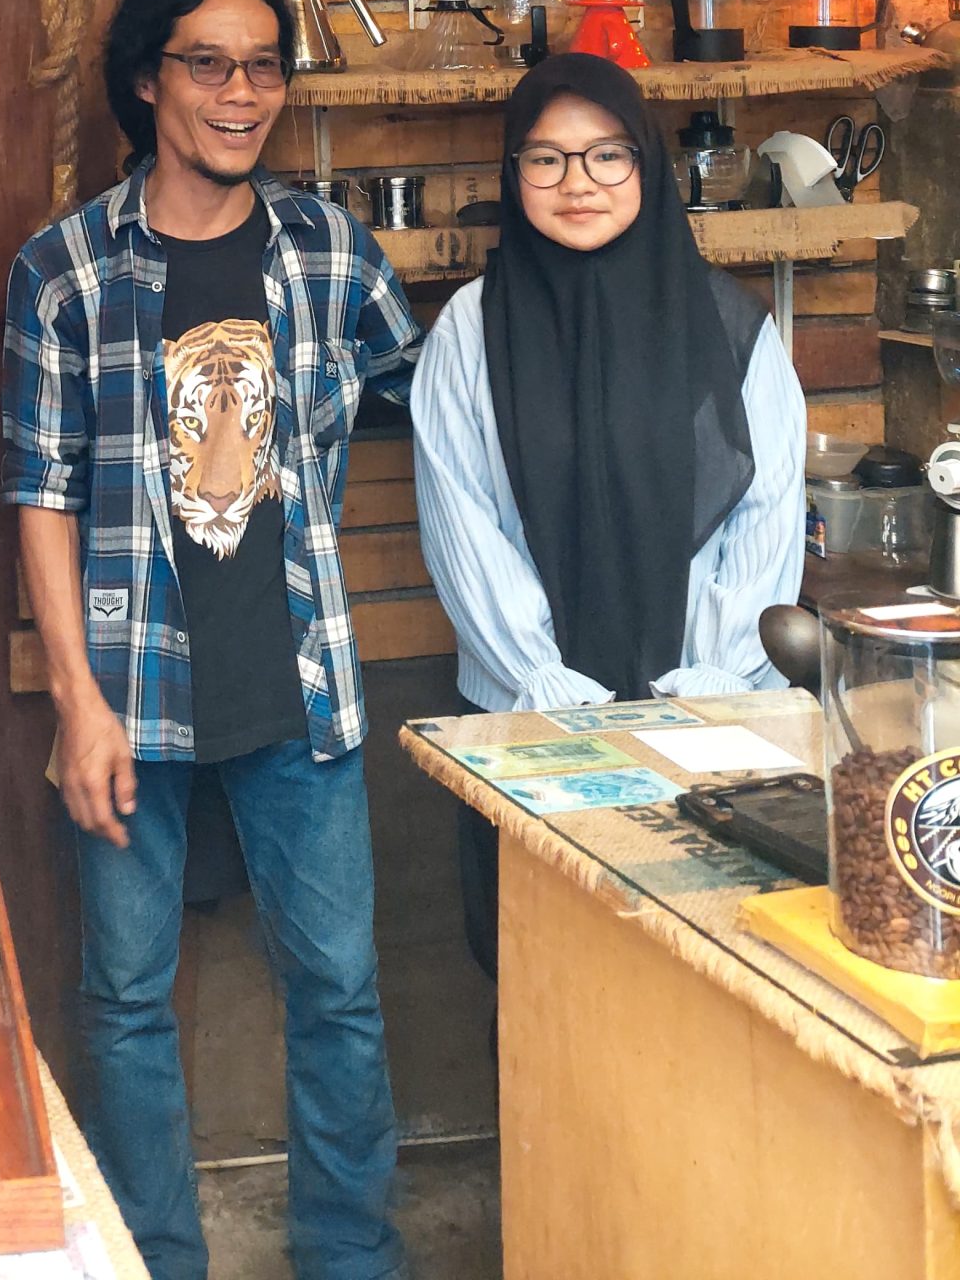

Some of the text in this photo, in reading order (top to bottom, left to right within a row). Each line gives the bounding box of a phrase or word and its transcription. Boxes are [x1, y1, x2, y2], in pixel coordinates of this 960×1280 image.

[93, 596, 124, 606] THOUGHT
[901, 758, 960, 804] HT C
